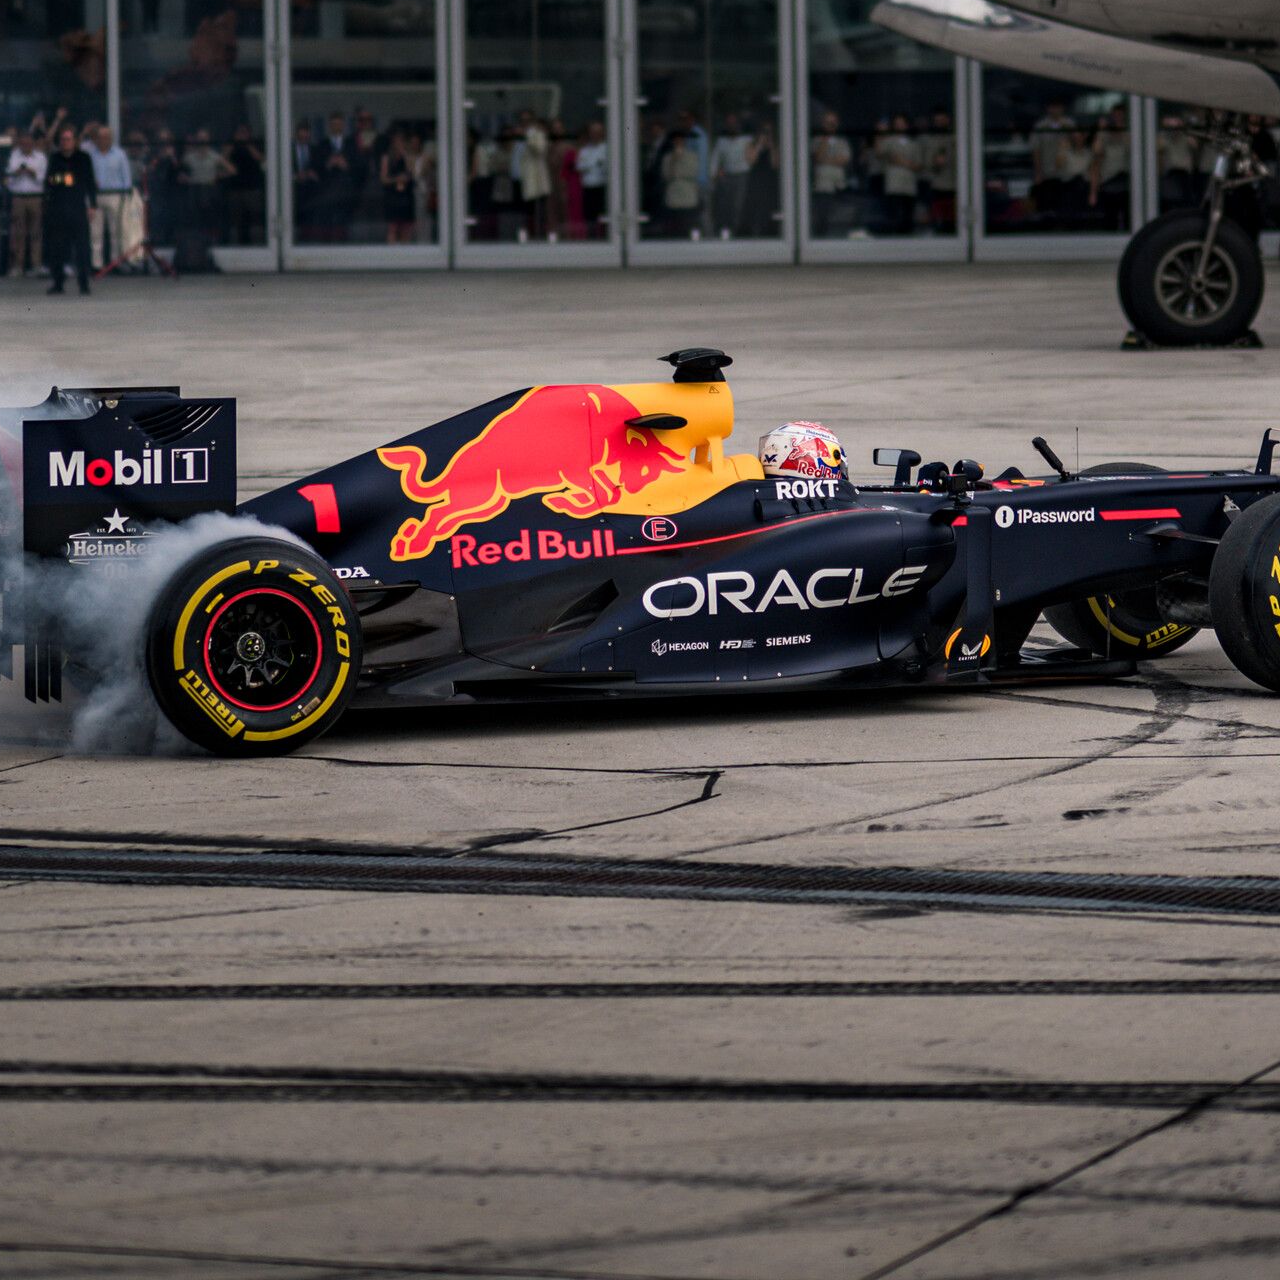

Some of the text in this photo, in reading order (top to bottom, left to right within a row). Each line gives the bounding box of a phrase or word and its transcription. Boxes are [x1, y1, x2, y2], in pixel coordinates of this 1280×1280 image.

[49, 449, 162, 487] Mobil
[798, 460, 824, 479] Red
[298, 483, 341, 533] 1
[776, 480, 839, 500] ROKT
[650, 520, 668, 540] E
[1017, 507, 1095, 524] 1Password
[451, 529, 616, 569] Red Bull
[252, 559, 351, 658] P ZERO
[642, 565, 928, 618] ORACLE
[669, 642, 709, 651] HEXAGON
[765, 634, 811, 647] SIEMENS
[179, 669, 246, 738] PIRELLI
